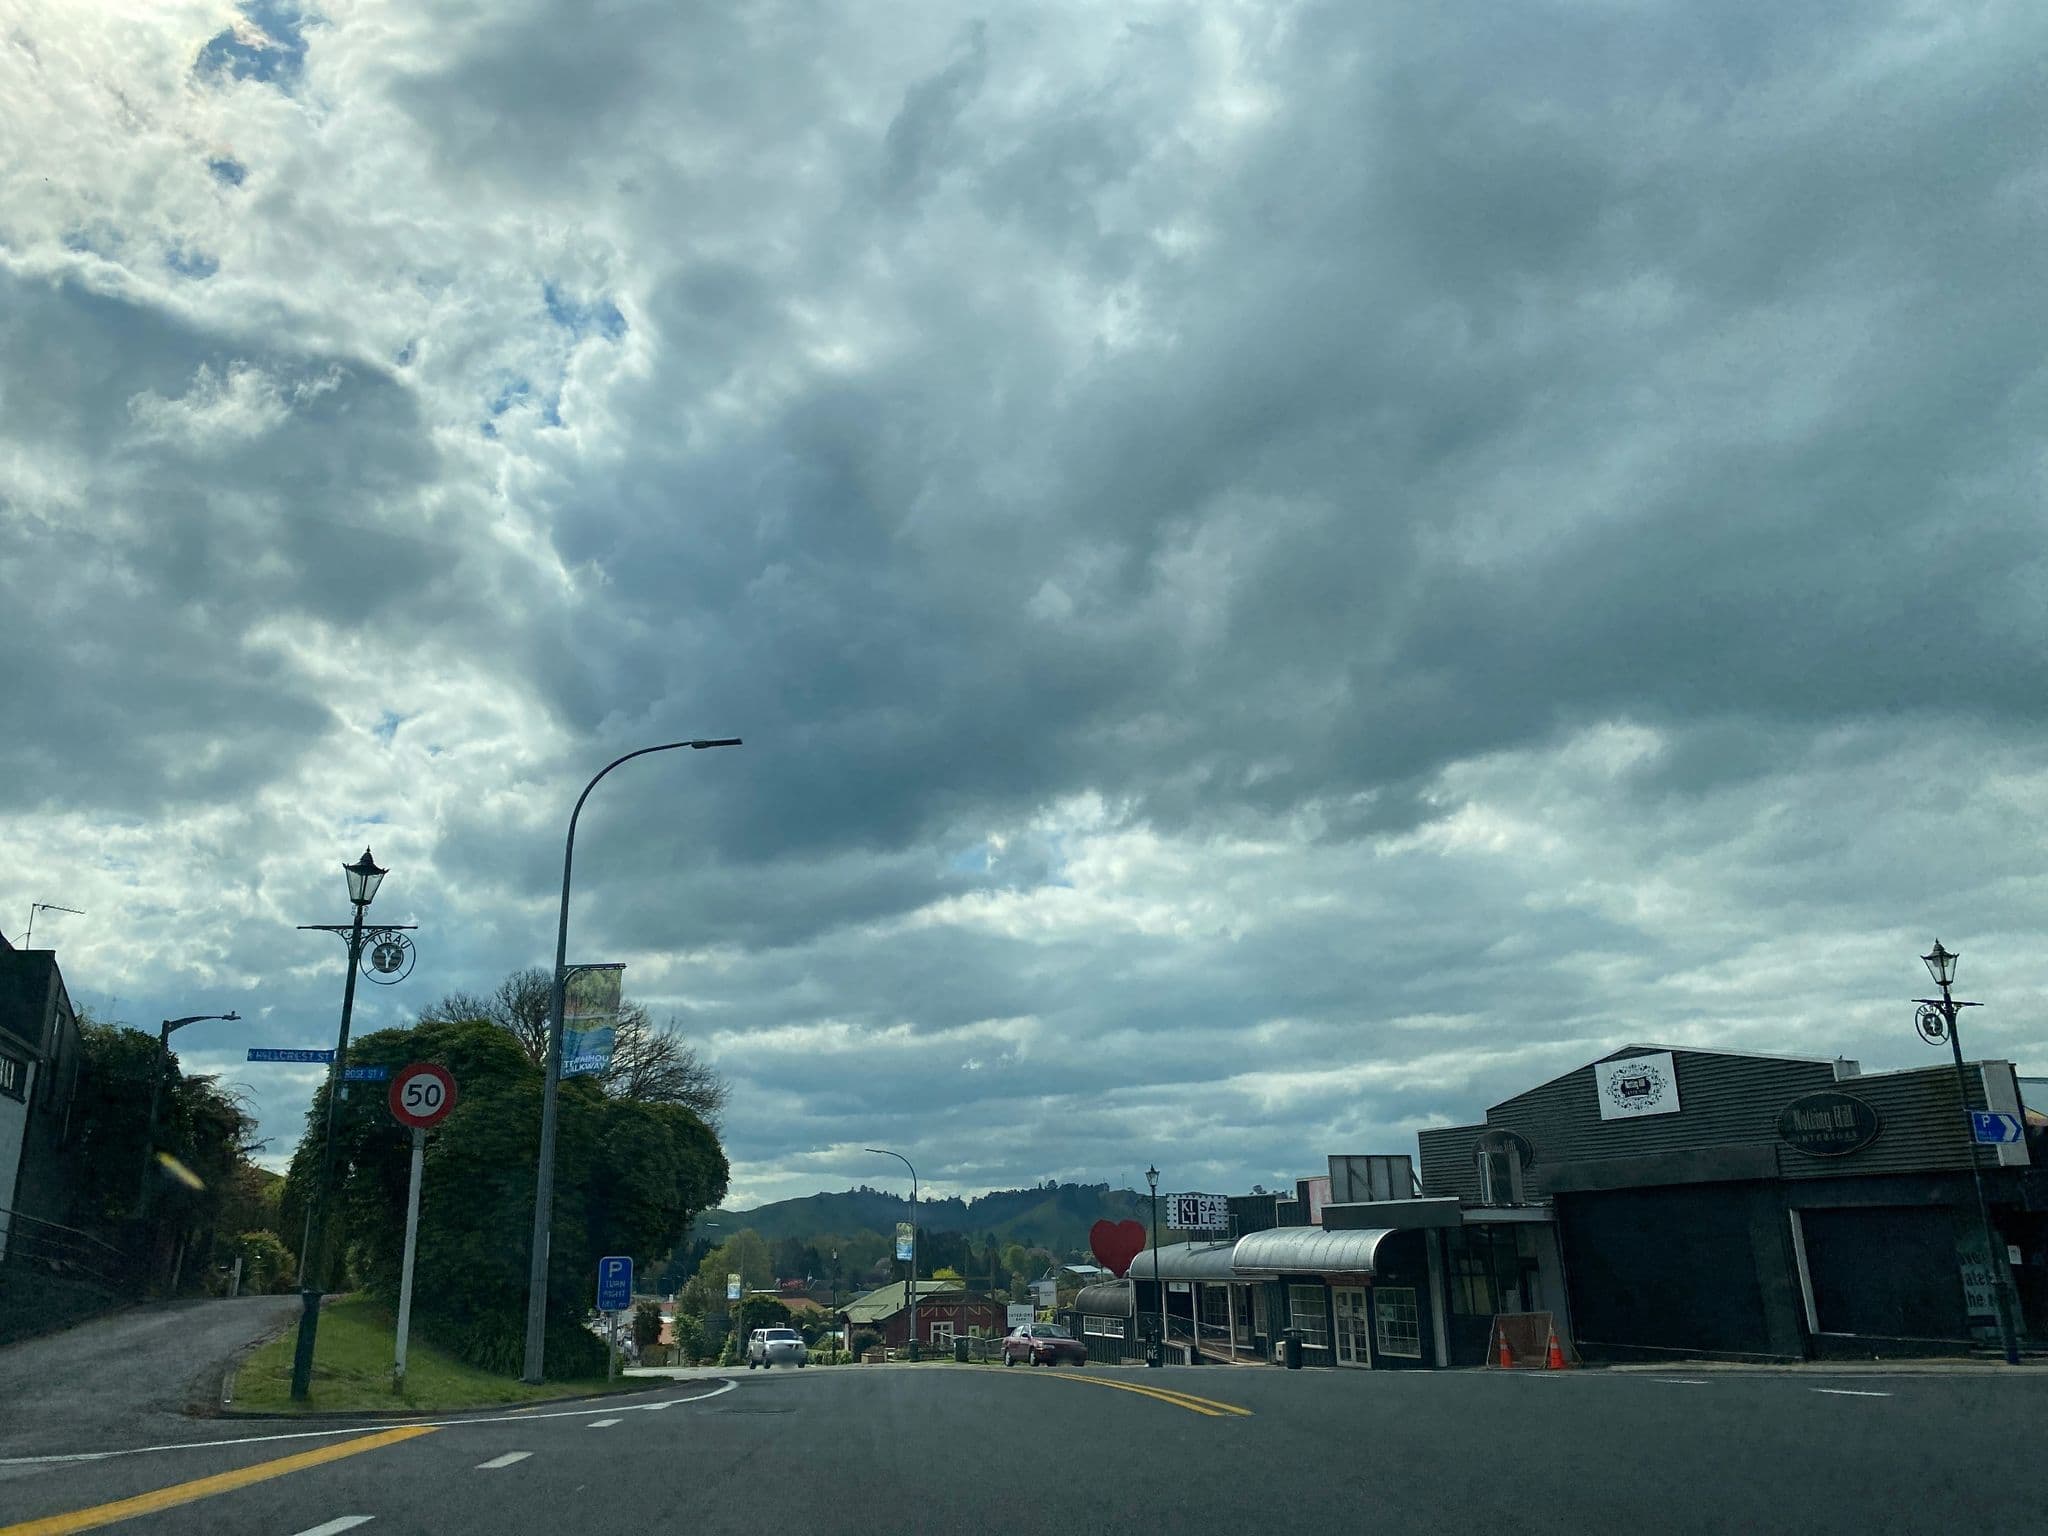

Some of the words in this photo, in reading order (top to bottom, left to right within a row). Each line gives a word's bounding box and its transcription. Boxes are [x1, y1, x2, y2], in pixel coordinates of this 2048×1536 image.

[371, 931, 411, 949] TIRAU
[255, 1050, 314, 1061] HILLCREST
[318, 1051, 330, 1061] ST
[344, 1069, 364, 1079] ROSE
[367, 1069, 378, 1079] ST
[406, 1084, 442, 1108] 50
[1981, 1115, 1991, 1128] P
[1181, 1200, 1194, 1212] KI
[1199, 1201, 1217, 1213] SA
[1181, 1212, 1197, 1224] LT
[1201, 1213, 1217, 1225] LE
[609, 1261, 623, 1278] P
